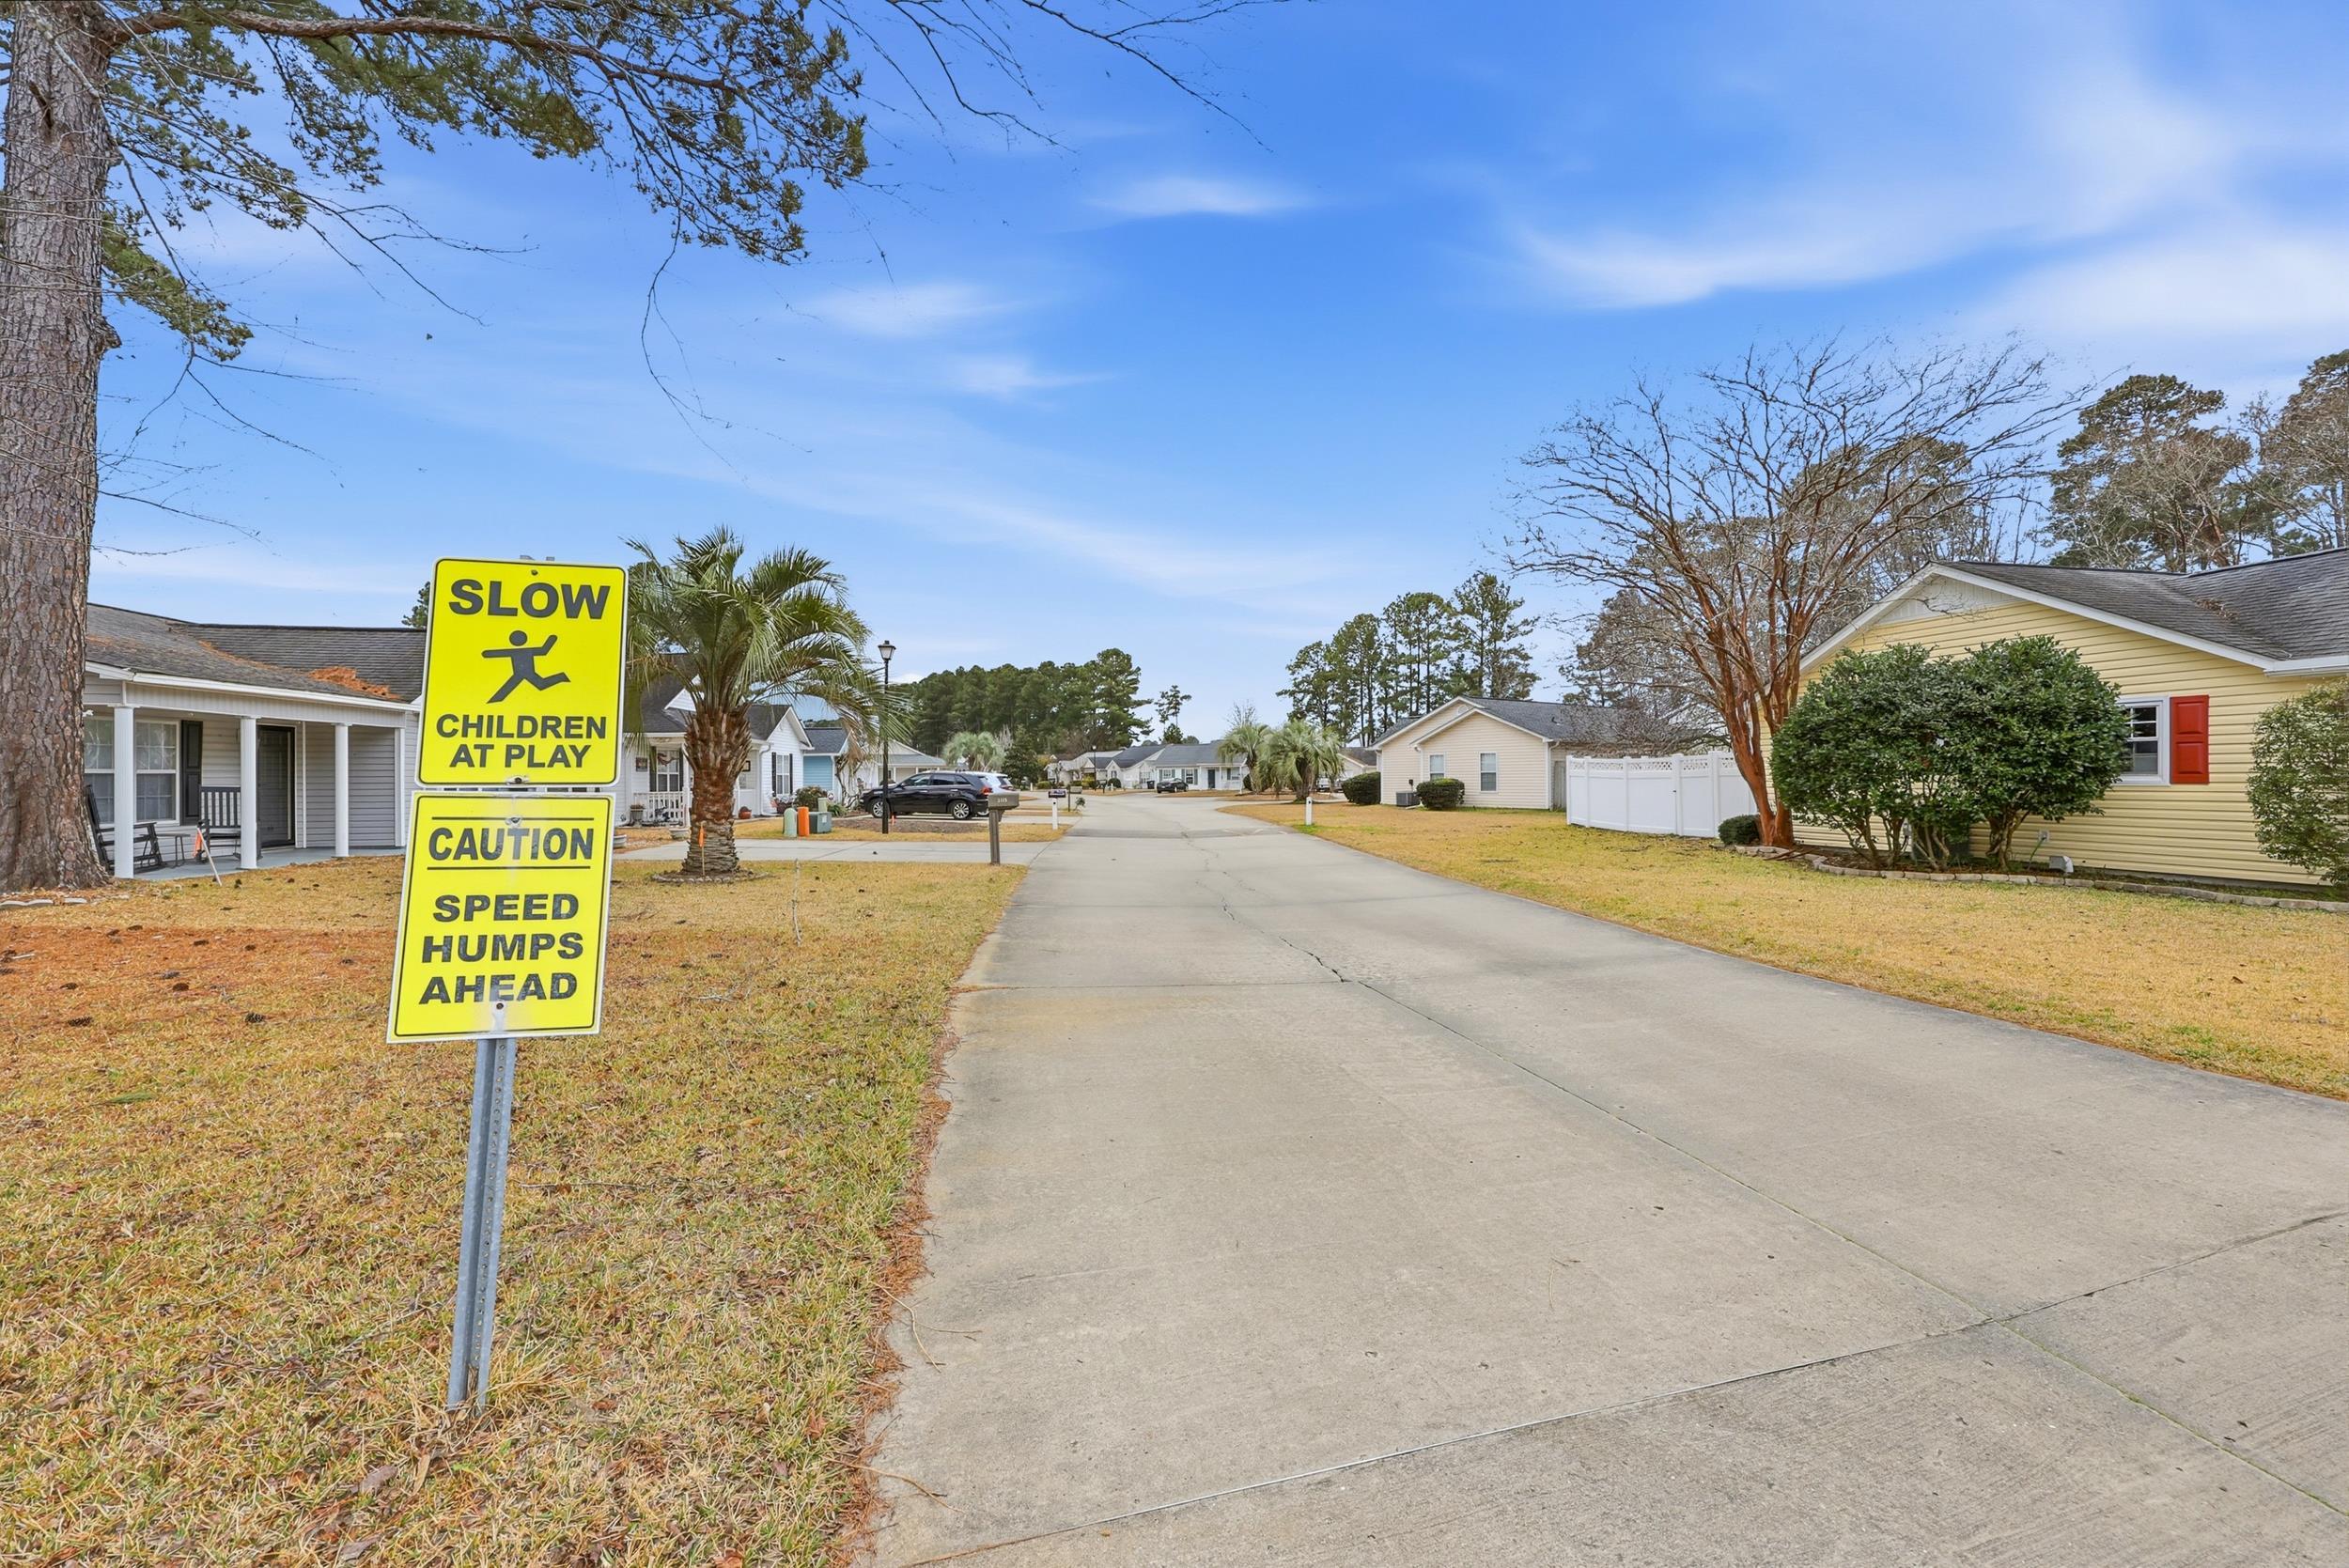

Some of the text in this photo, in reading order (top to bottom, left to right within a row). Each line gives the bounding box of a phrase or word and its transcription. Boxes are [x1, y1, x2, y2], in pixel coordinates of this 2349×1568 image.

[448, 578, 611, 620] SLOW
[436, 713, 607, 739] CHILDREN
[449, 743, 592, 768] AT PLAY
[428, 827, 594, 862] CAUTION
[432, 893, 579, 923] SPEED
[421, 932, 583, 964] HUMPS
[419, 971, 578, 1005] AHEAD
